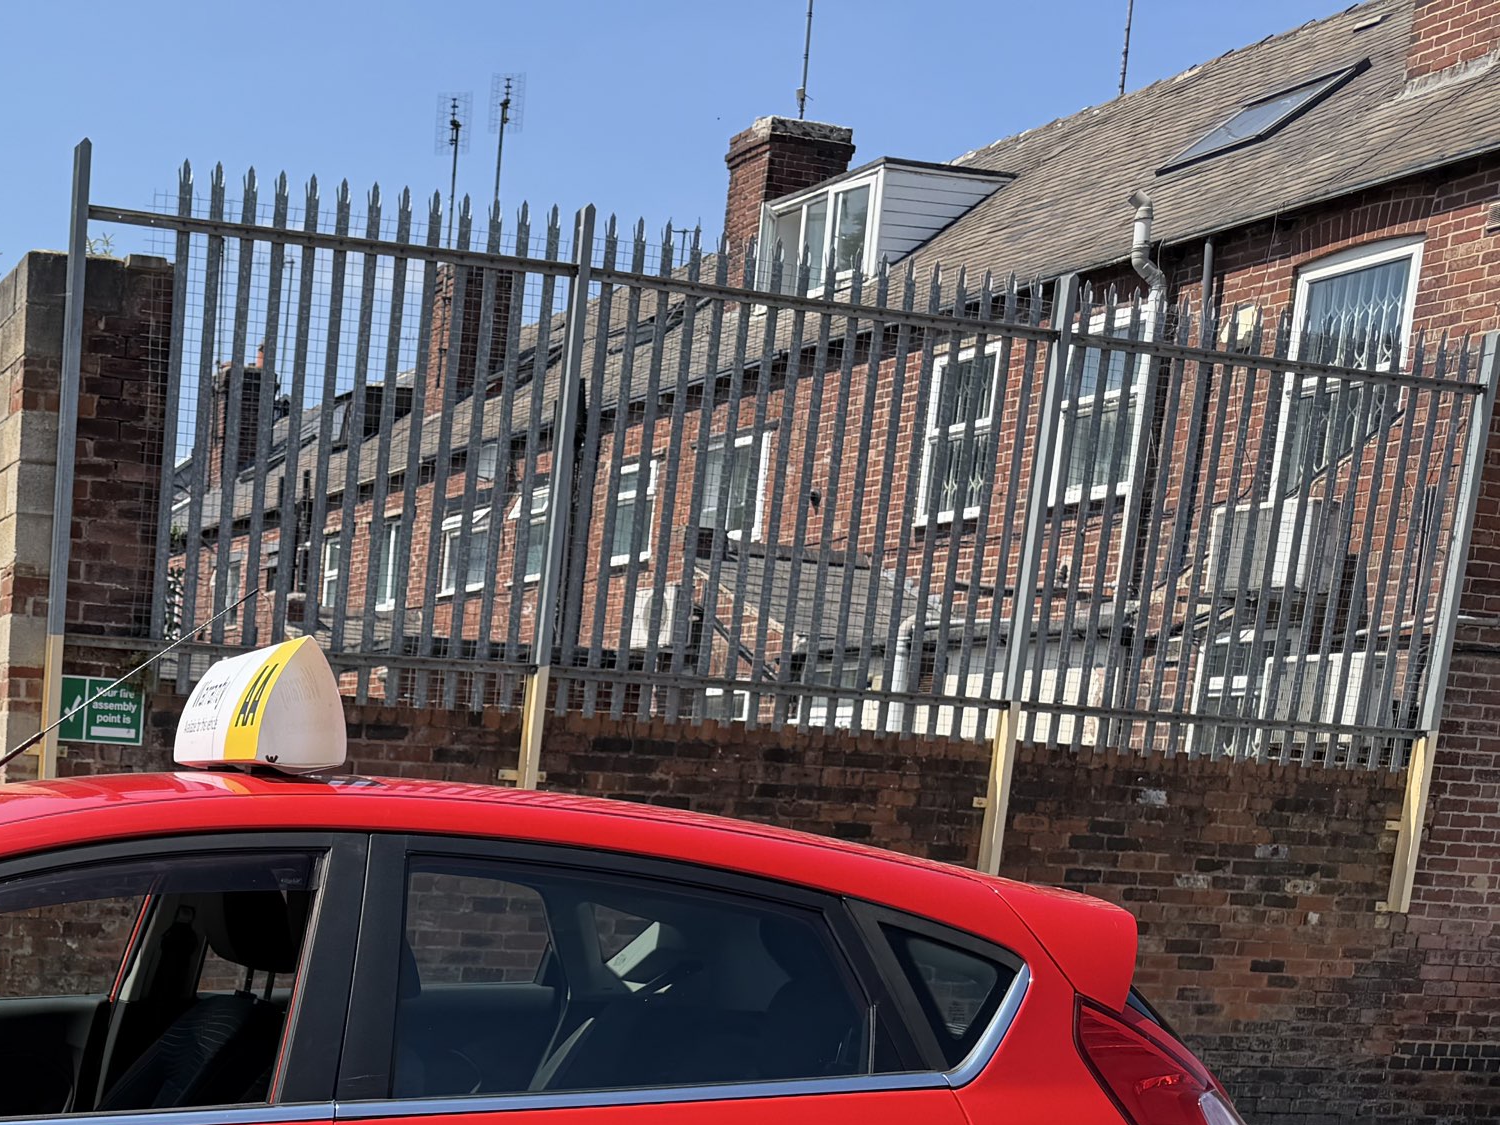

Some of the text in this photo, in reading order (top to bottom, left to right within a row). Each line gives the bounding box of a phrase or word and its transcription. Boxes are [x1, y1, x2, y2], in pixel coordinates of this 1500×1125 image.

[119, 688, 135, 699] fire
[235, 663, 279, 727] AA
[92, 701, 137, 714] assembly
[96, 713, 131, 724] point is
